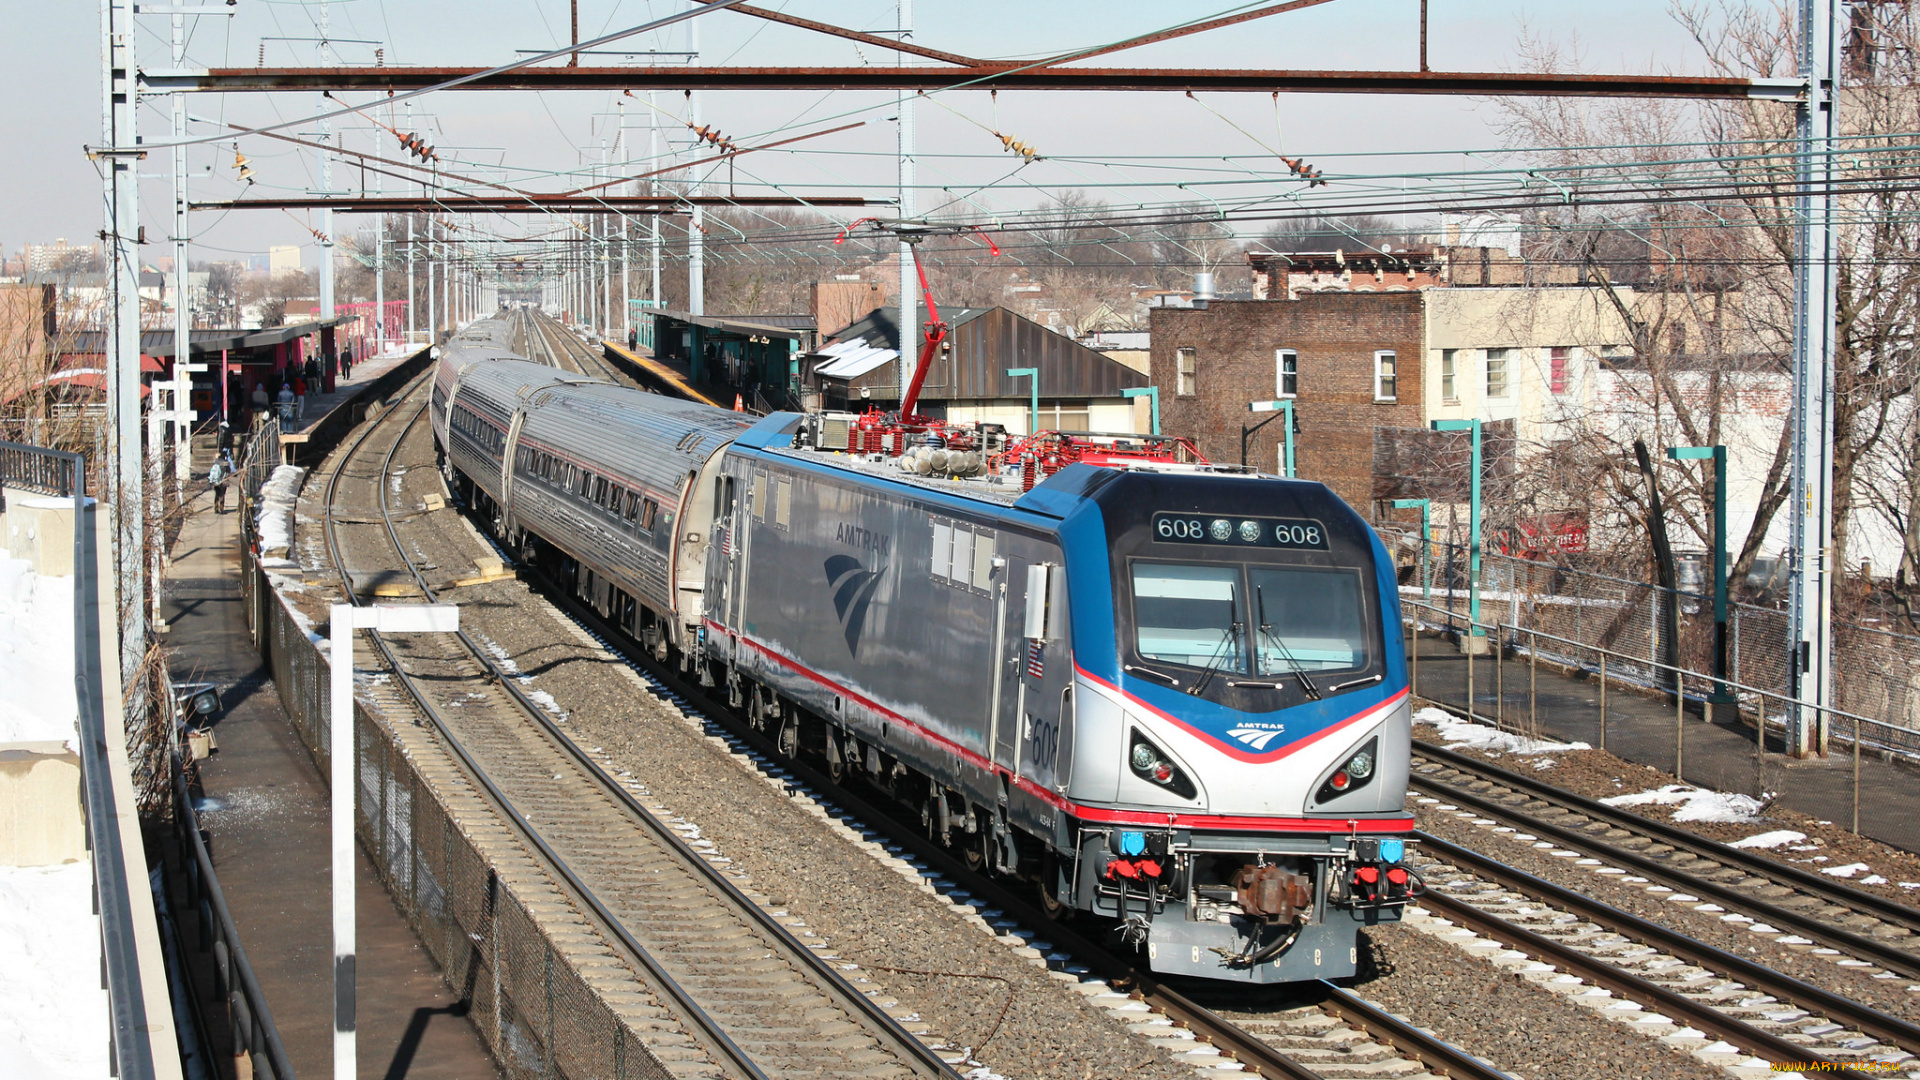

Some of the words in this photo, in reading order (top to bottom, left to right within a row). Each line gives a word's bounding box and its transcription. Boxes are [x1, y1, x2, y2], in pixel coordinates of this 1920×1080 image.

[836, 521, 889, 557] AMTRAK
[1158, 518, 1204, 539] 608
[1275, 524, 1321, 545] 608
[1236, 722, 1285, 730] AMTRAK
